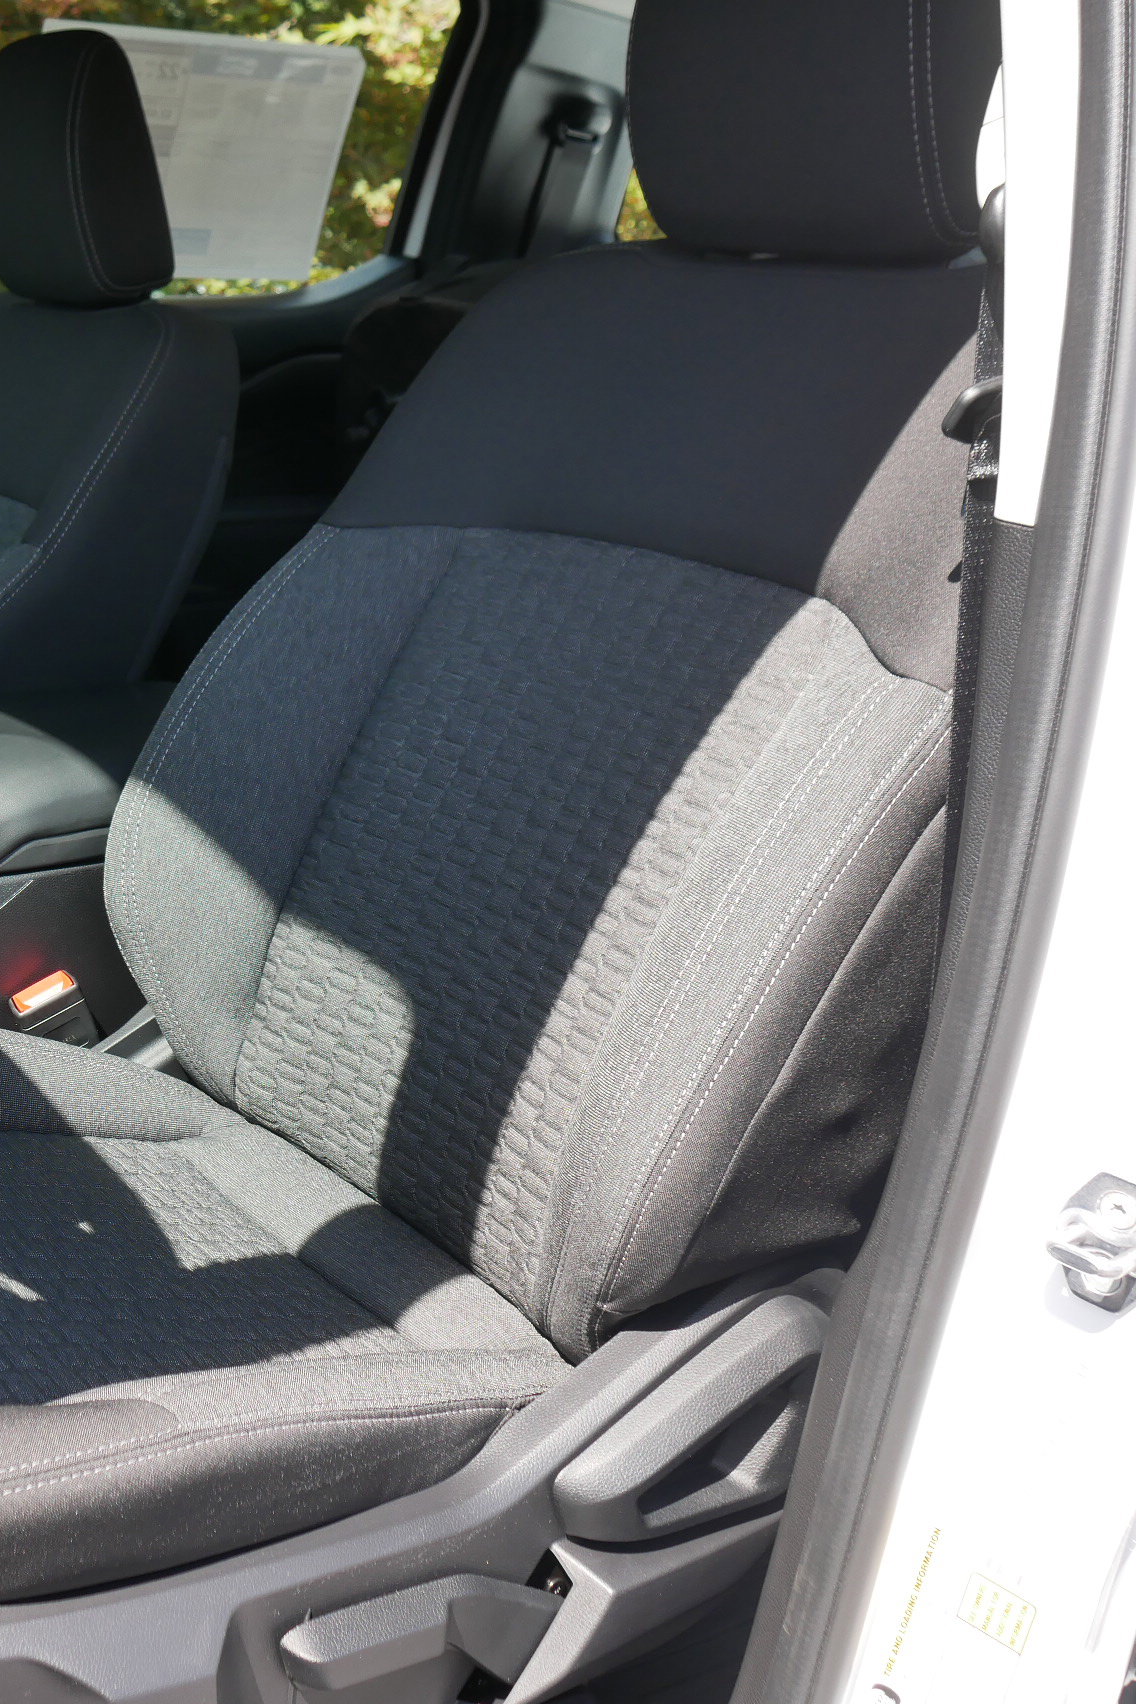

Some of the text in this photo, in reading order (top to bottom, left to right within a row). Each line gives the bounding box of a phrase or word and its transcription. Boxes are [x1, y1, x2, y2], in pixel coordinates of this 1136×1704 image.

[884, 1528, 941, 1677] TIRE AND LOADING INFORMATION
